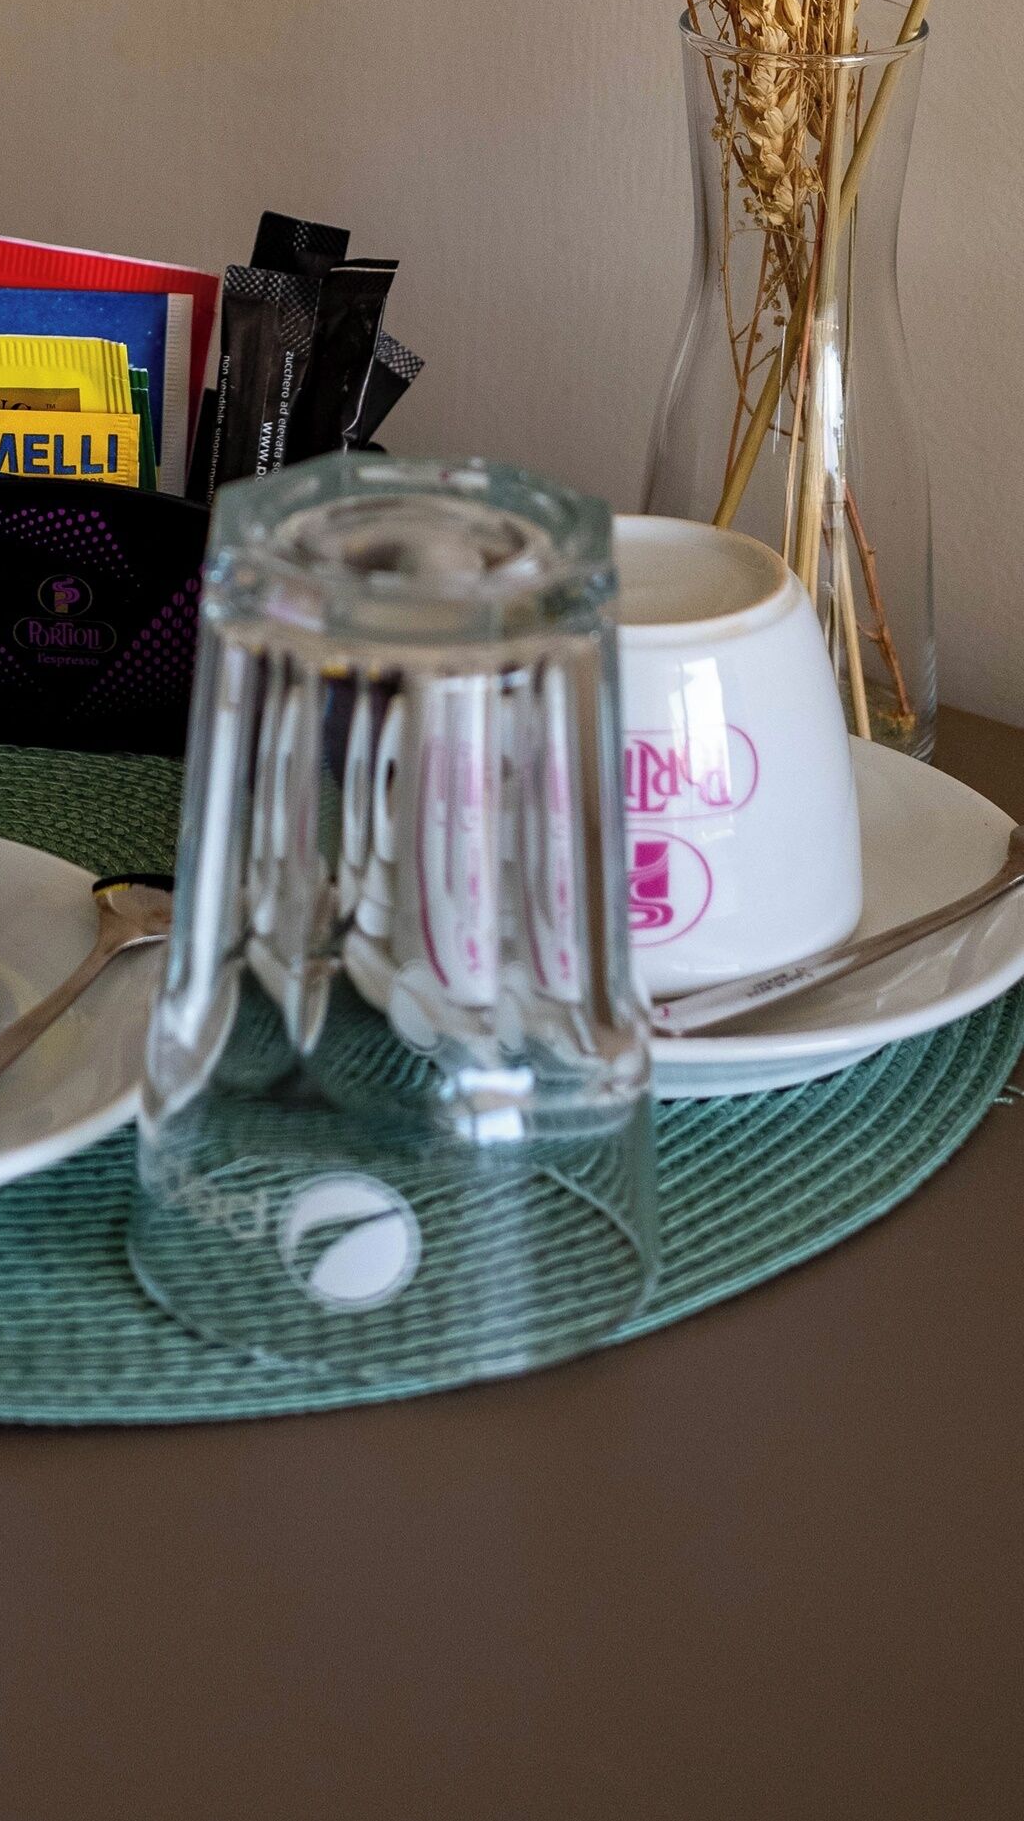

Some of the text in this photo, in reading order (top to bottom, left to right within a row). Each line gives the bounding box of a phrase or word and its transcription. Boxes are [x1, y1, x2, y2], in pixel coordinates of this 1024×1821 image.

[222, 355, 230, 375] non
[281, 350, 295, 398] zucchero
[279, 401, 289, 415] ad
[275, 418, 287, 459] elevata
